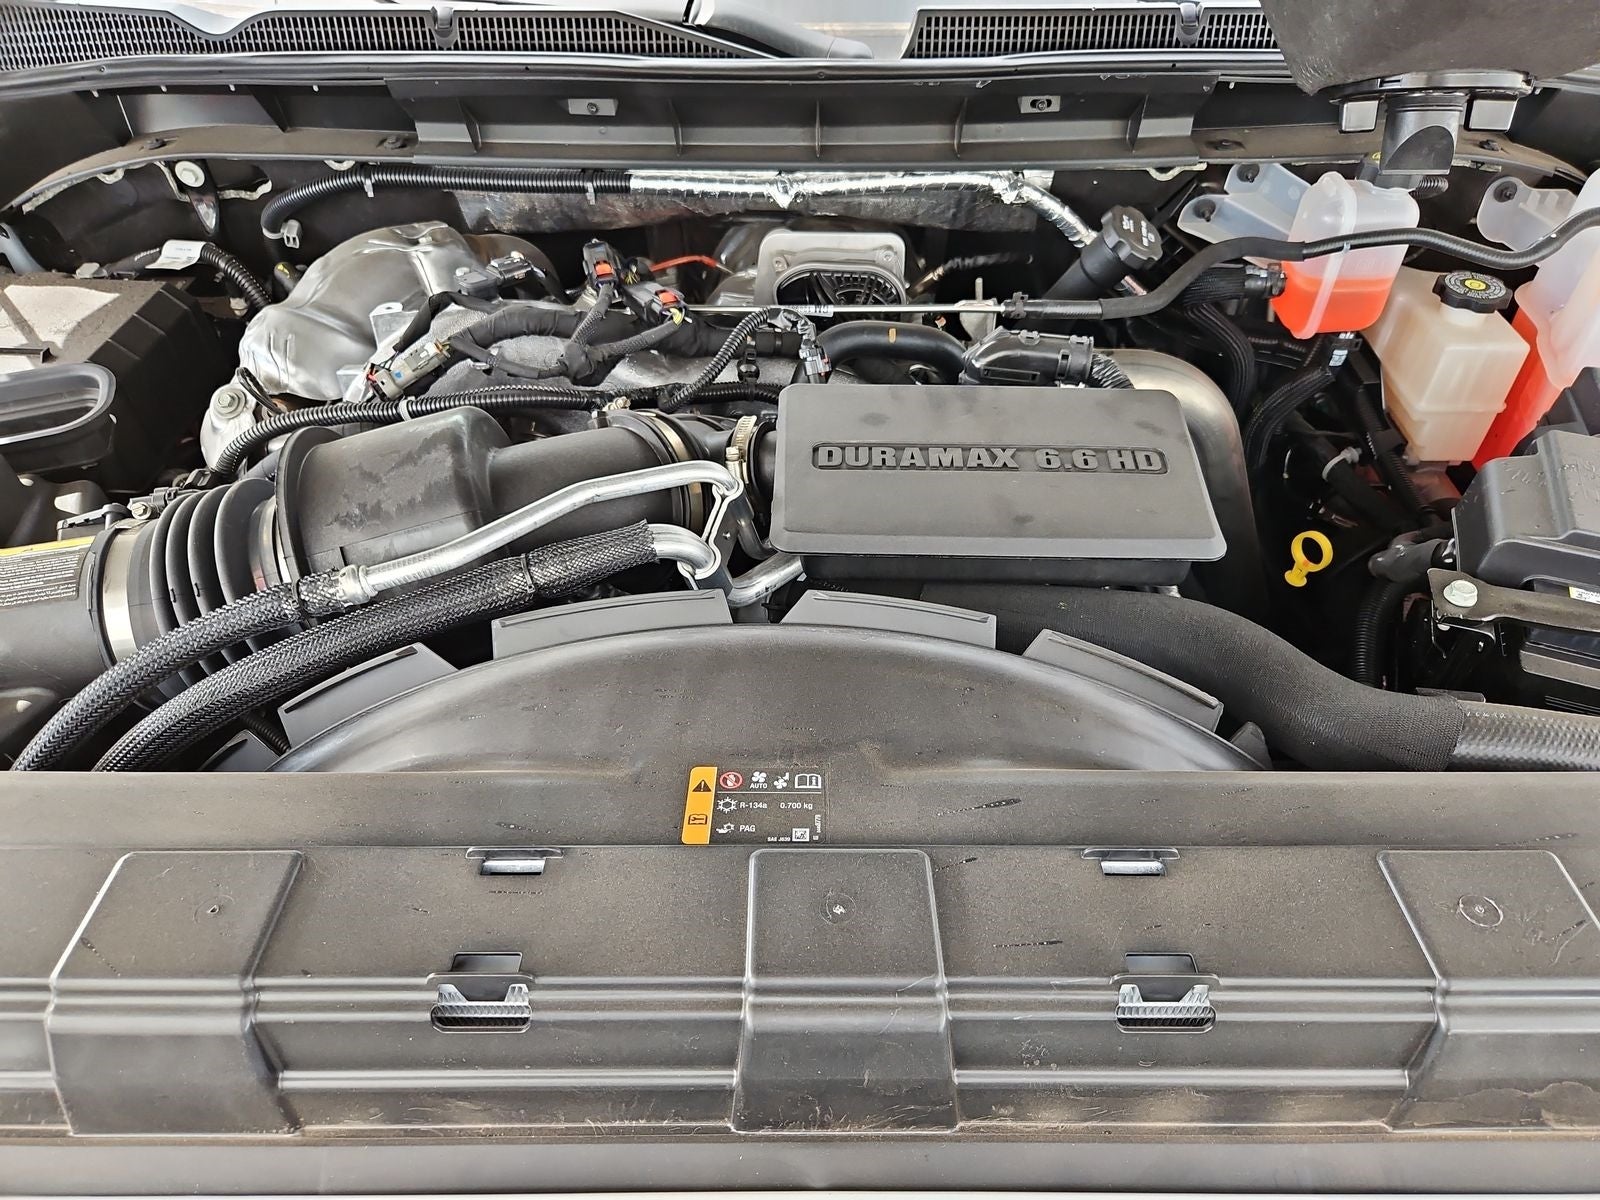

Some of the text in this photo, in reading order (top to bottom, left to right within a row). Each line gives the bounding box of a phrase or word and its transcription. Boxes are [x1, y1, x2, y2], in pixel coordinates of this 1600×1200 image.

[817, 446, 1163, 472] DURAMAX 6.6 HD
[739, 801, 813, 810] R-134a 0.700 kg
[739, 824, 756, 832] PAG
